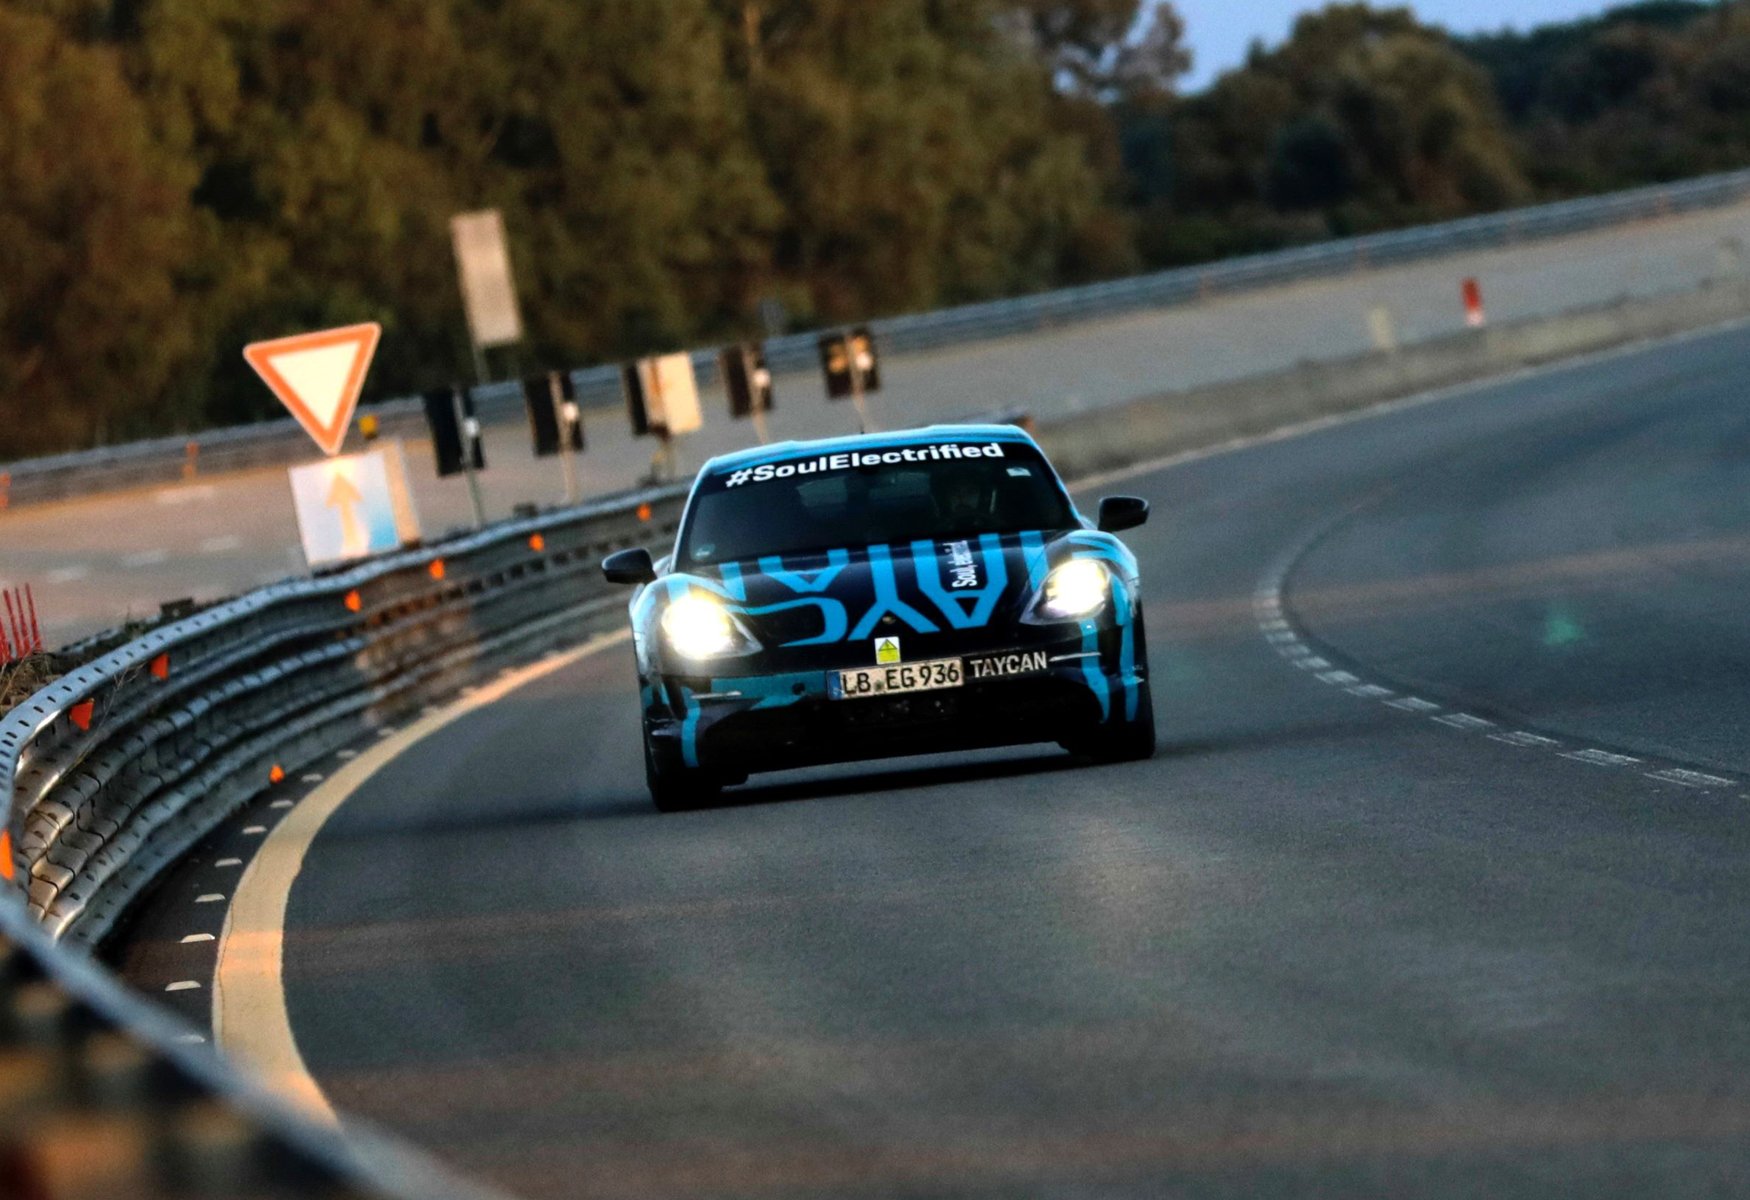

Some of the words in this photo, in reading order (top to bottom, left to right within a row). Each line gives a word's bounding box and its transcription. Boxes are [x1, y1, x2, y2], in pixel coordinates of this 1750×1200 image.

[725, 443, 1004, 487] #SoulElectrified
[970, 651, 1048, 678] TAYCAN
[842, 672, 871, 695] LB
